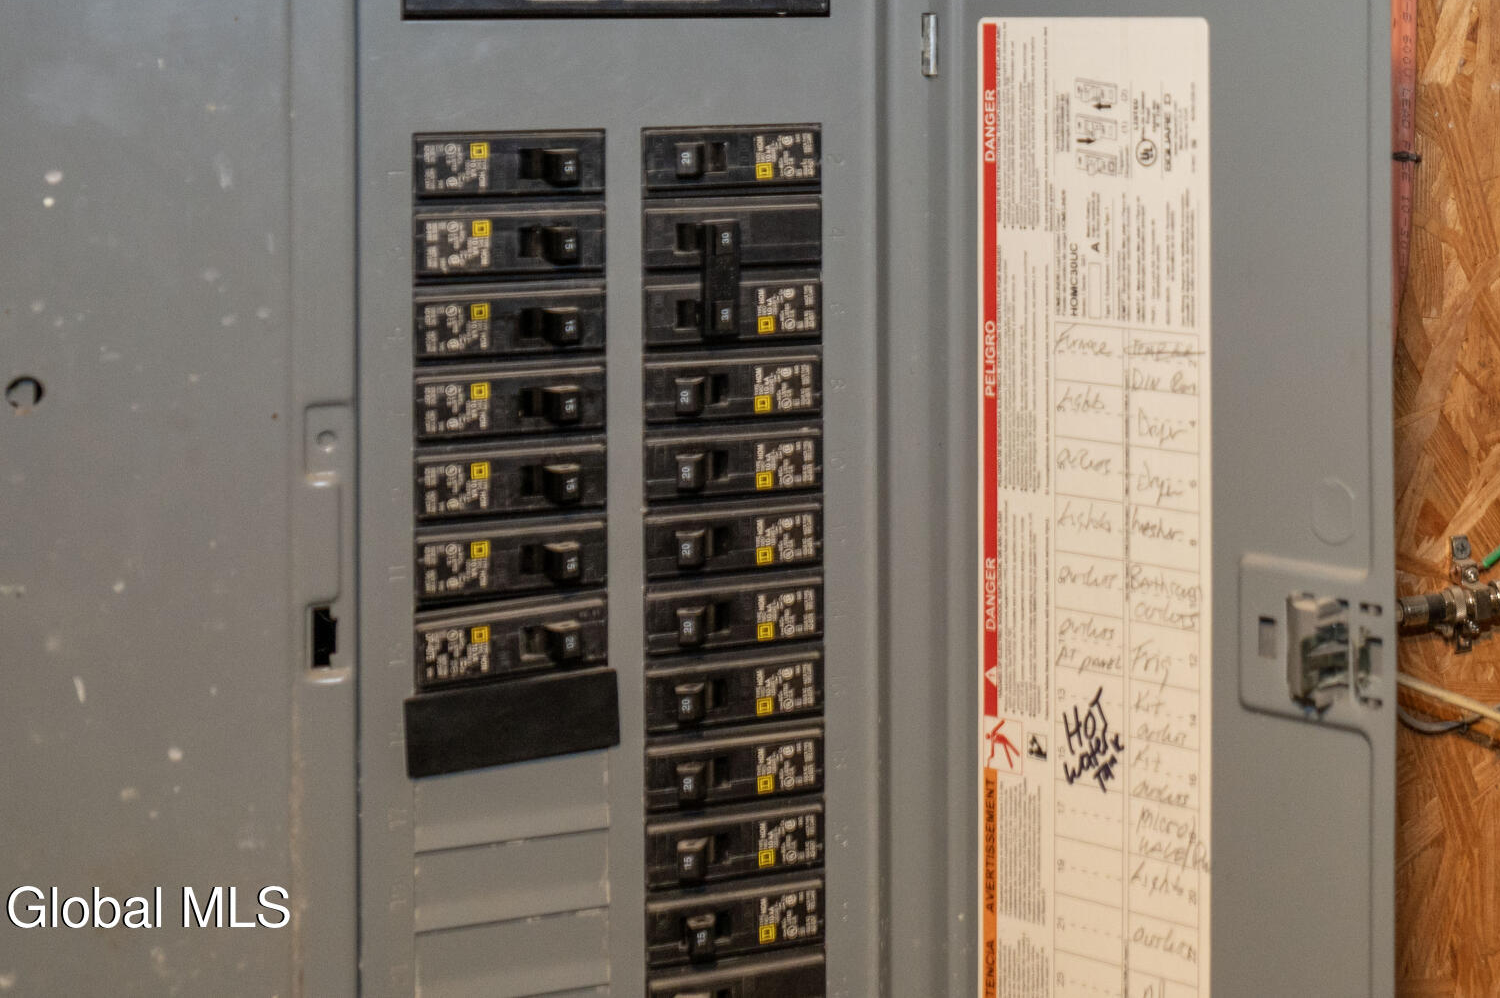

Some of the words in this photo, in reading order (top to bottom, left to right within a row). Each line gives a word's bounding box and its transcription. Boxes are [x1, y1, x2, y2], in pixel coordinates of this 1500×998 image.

[1400, 88, 1411, 130] LEAD
[985, 89, 996, 162] DANGER
[681, 151, 690, 166] 20
[1400, 140, 1411, 182] FEE
[565, 160, 574, 174] 15
[565, 238, 574, 252] 15
[721, 231, 730, 245] 30
[720, 308, 729, 322] 30
[565, 319, 574, 333] 15
[985, 320, 996, 397] PELIGRO
[680, 390, 689, 404] 20
[565, 399, 574, 413] 15
[681, 466, 690, 481] 20
[566, 478, 575, 493] 15
[681, 542, 690, 557] 20
[566, 556, 576, 572] 15
[985, 557, 996, 632] DANGER
[683, 620, 692, 635] 20
[566, 635, 576, 651] 20
[681, 698, 691, 713] 20
[683, 777, 692, 792] 20
[985, 778, 995, 913] AVERTISSEMENT
[683, 856, 692, 870] 15
